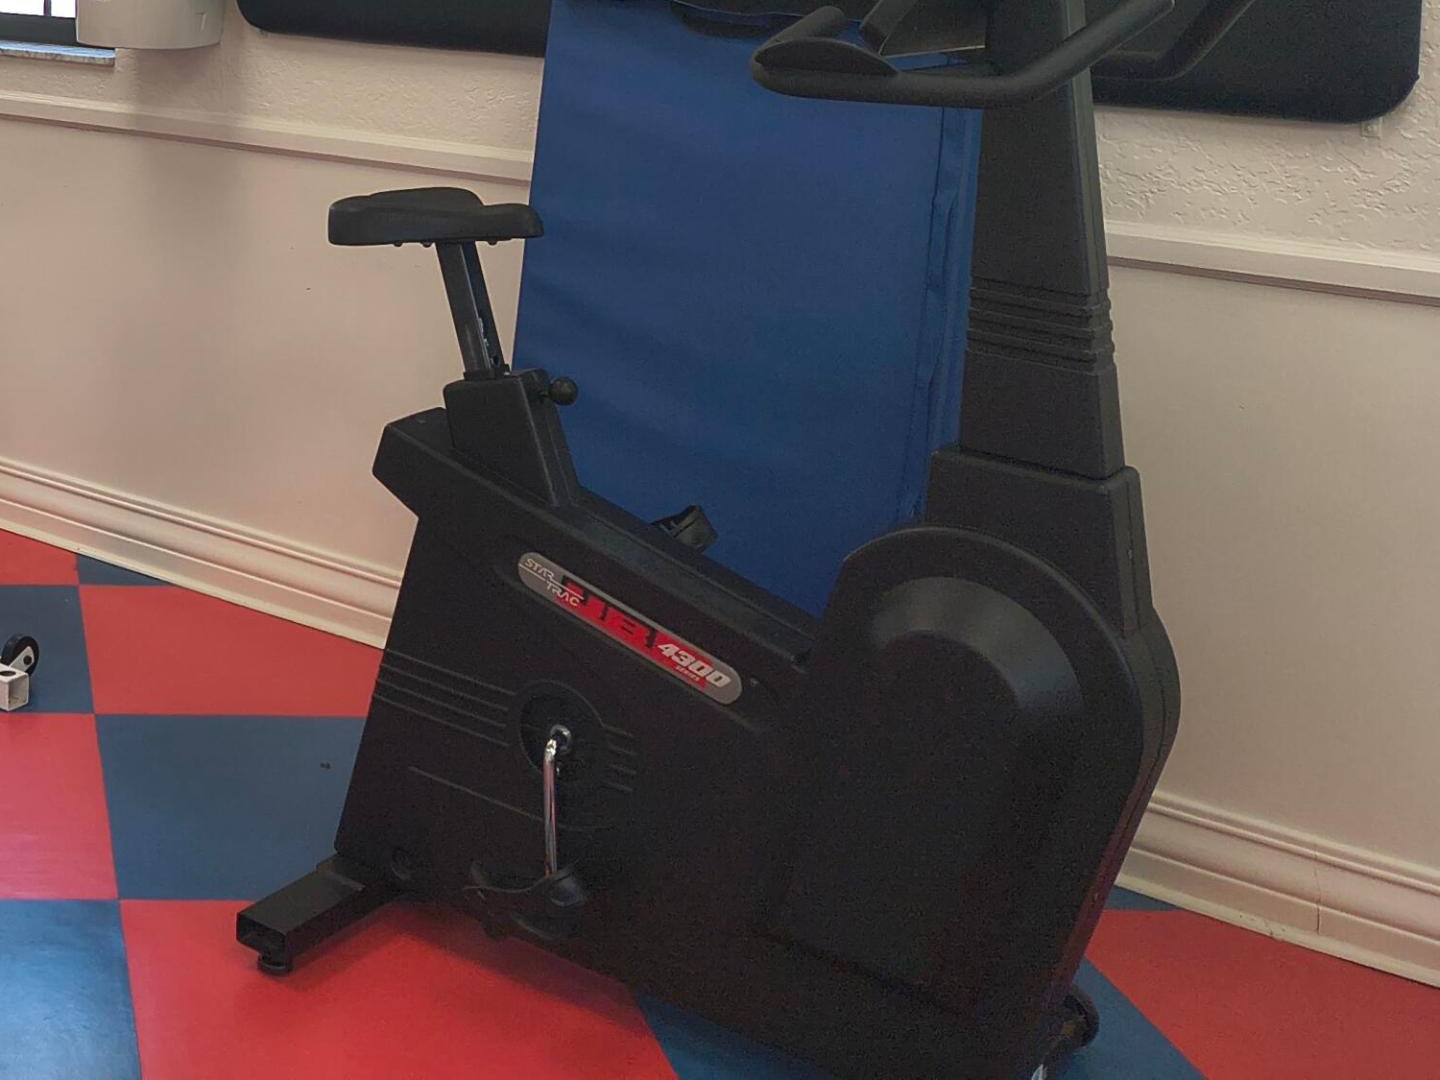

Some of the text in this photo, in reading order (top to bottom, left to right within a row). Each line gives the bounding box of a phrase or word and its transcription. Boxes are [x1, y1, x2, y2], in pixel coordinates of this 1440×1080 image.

[524, 558, 554, 581] STAR
[545, 580, 580, 607] TRAC
[658, 643, 731, 688] 4300
